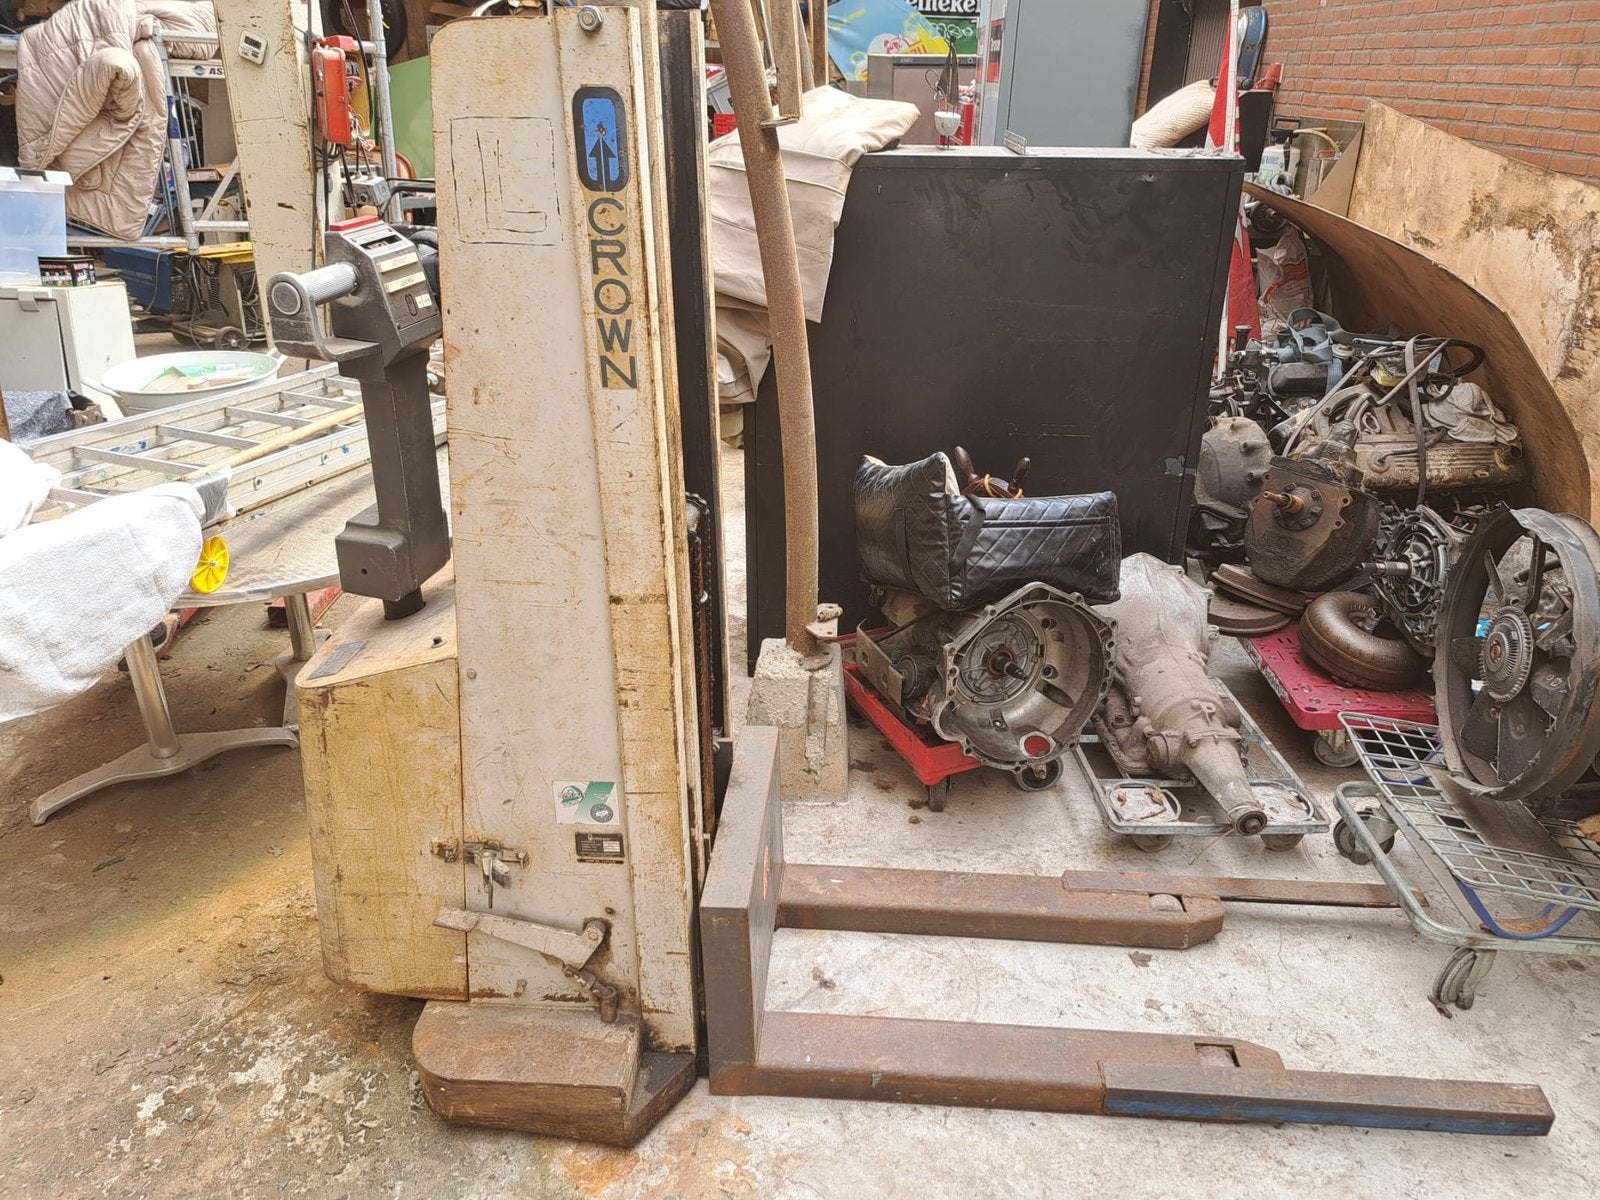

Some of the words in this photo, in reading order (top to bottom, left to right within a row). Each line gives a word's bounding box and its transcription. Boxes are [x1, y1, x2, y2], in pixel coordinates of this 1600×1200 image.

[906, 0, 980, 13] eineke
[209, 67, 223, 76] AS
[587, 197, 638, 389] CROWN
